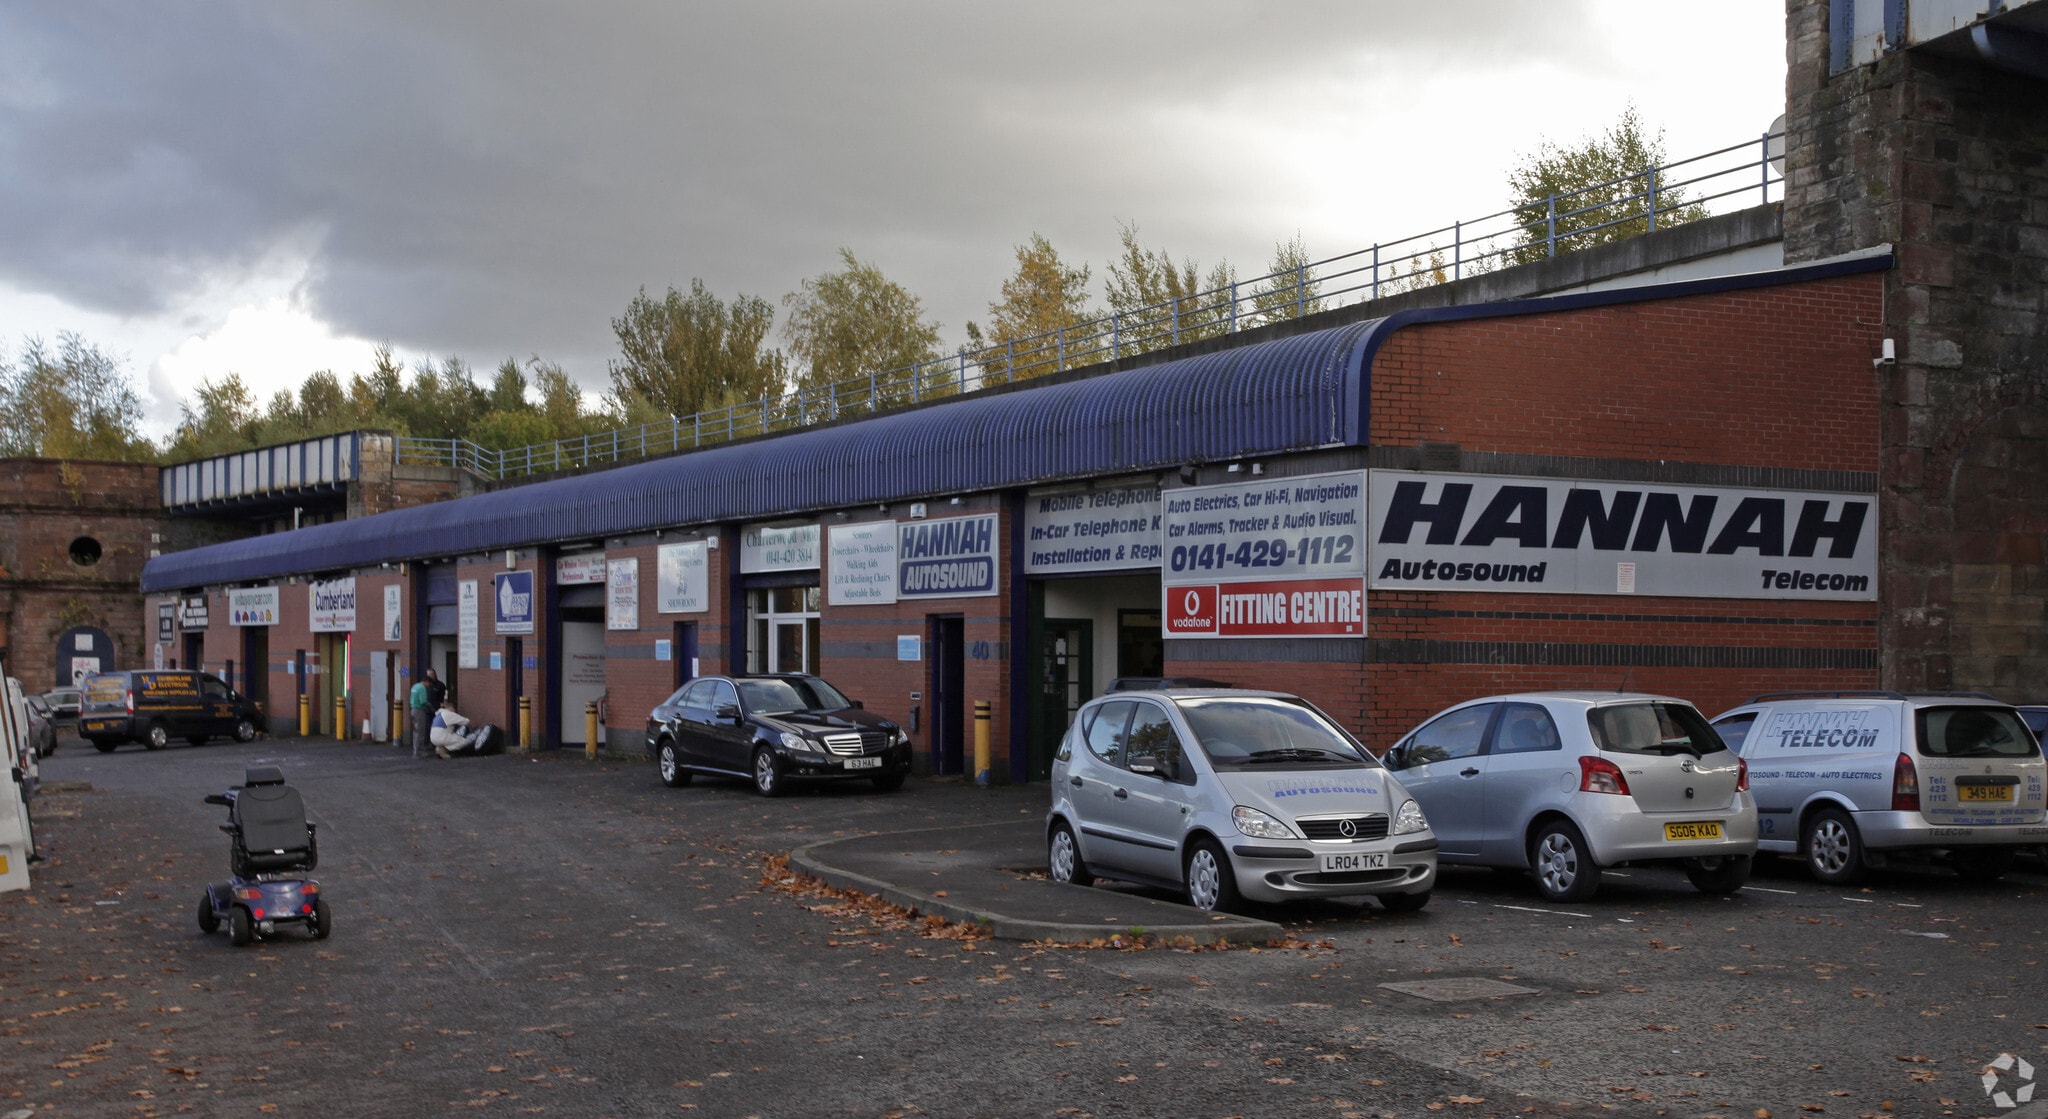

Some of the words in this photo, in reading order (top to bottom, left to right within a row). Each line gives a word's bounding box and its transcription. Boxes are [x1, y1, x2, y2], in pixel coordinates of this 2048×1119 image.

[1040, 494, 1084, 513] Mobile
[1088, 488, 1161, 510] Telephone
[1168, 498, 1191, 515] Auto
[1193, 494, 1240, 511] Electrics,
[1244, 491, 1262, 508] Car
[1264, 487, 1290, 506] Hi-Fi,
[1295, 483, 1358, 503] Navigation
[1031, 525, 1069, 540] In-Car
[1074, 518, 1147, 539] Telephone
[1169, 523, 1185, 538] Car
[1187, 519, 1225, 537] Alarms,
[1229, 515, 1270, 533] Tracker
[1272, 515, 1280, 530] &
[1283, 512, 1315, 529] Audio
[1319, 509, 1357, 526] Visual.
[1378, 480, 1869, 559] HANNAH
[900, 518, 993, 559] HANNAH
[1031, 546, 1110, 566] Installation
[1115, 545, 1124, 561] &
[1170, 534, 1355, 573] 0141-429-1112
[905, 561, 988, 590] AUTOSOUND
[1379, 558, 1547, 584] Autosound
[1761, 569, 1869, 592] Telecom
[315, 587, 355, 612] Cumberland
[1221, 593, 1286, 625] FITTING
[1290, 590, 1361, 624] CENTRE
[1173, 615, 1211, 628] vodafone
[972, 640, 990, 661] 40
[1767, 711, 1869, 737] HANNAH
[1779, 729, 1879, 748] TELECOM
[1785, 771, 1815, 779] TELECOM
[1821, 771, 1840, 779] AUTO
[1842, 771, 1883, 780] ELECTRICS
[1929, 776, 1946, 784] Tel:
[2027, 775, 2040, 783] Tel:
[1275, 786, 1378, 798] AUTOSOUND
[1929, 785, 1946, 793] 429
[1929, 794, 1947, 802] 1112
[1968, 787, 1986, 800] 349
[1988, 787, 2006, 800] HAE
[2027, 784, 2041, 792] 429
[2027, 793, 2042, 801] 1112
[1670, 825, 1696, 838] SG06
[1929, 828, 1973, 836] TELECOM
[1327, 856, 1359, 870] LR04
[1363, 854, 1384, 868] TKZ
